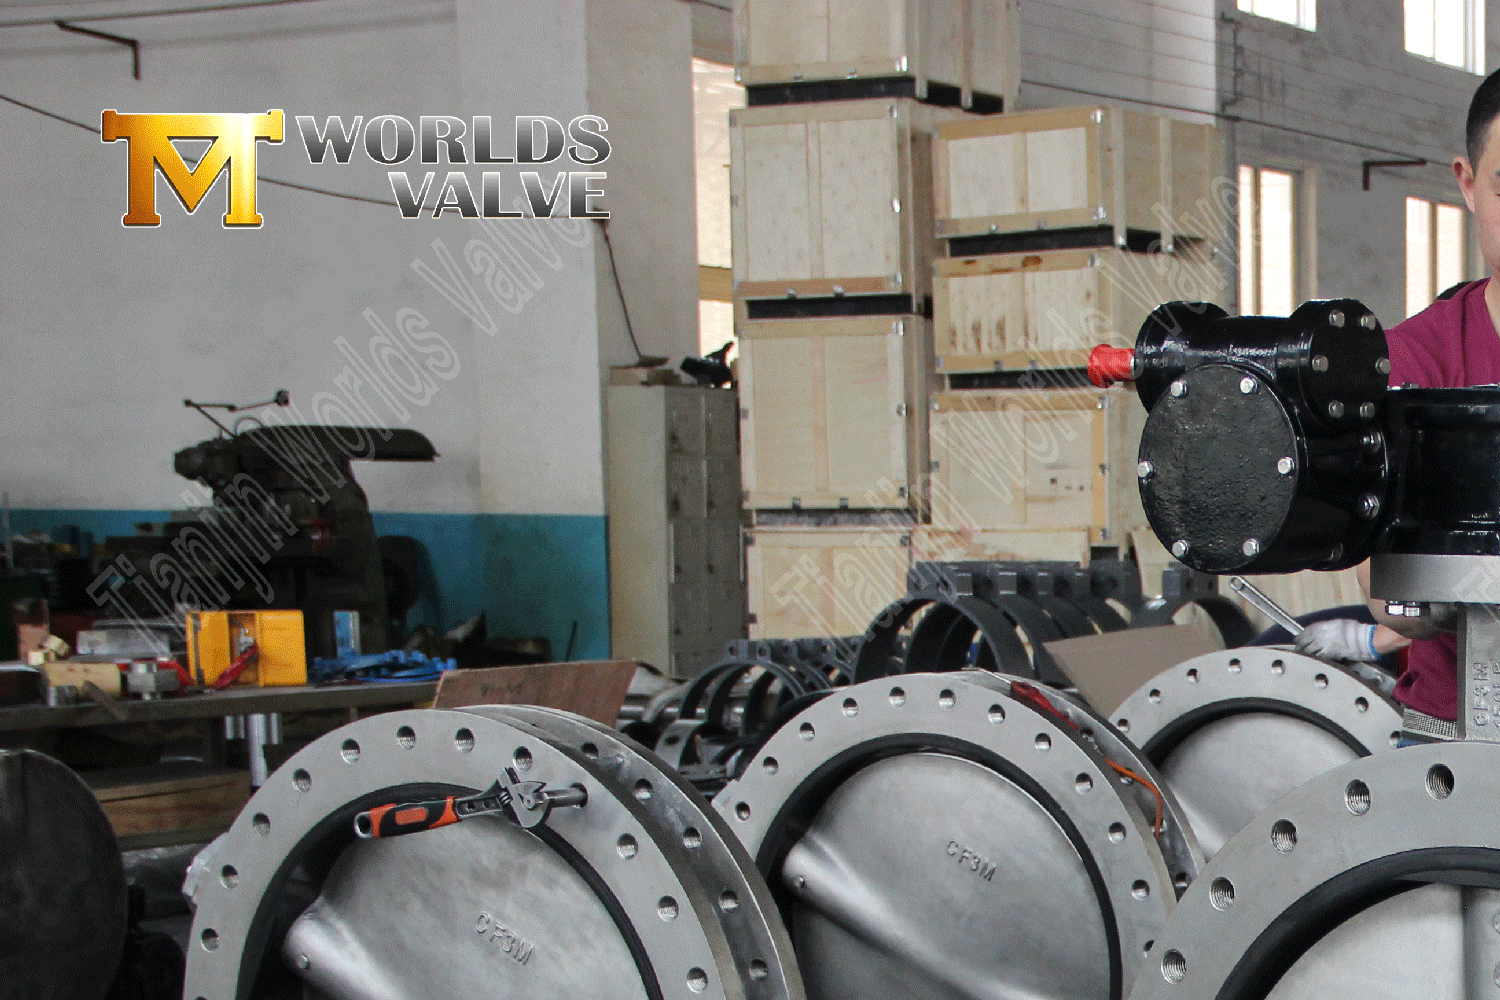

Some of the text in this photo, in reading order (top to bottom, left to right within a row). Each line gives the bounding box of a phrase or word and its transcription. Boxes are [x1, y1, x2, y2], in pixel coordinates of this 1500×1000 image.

[1473, 661, 1489, 727] CF3M
[946, 838, 997, 882] CF3M
[475, 910, 534, 966] CF3M
